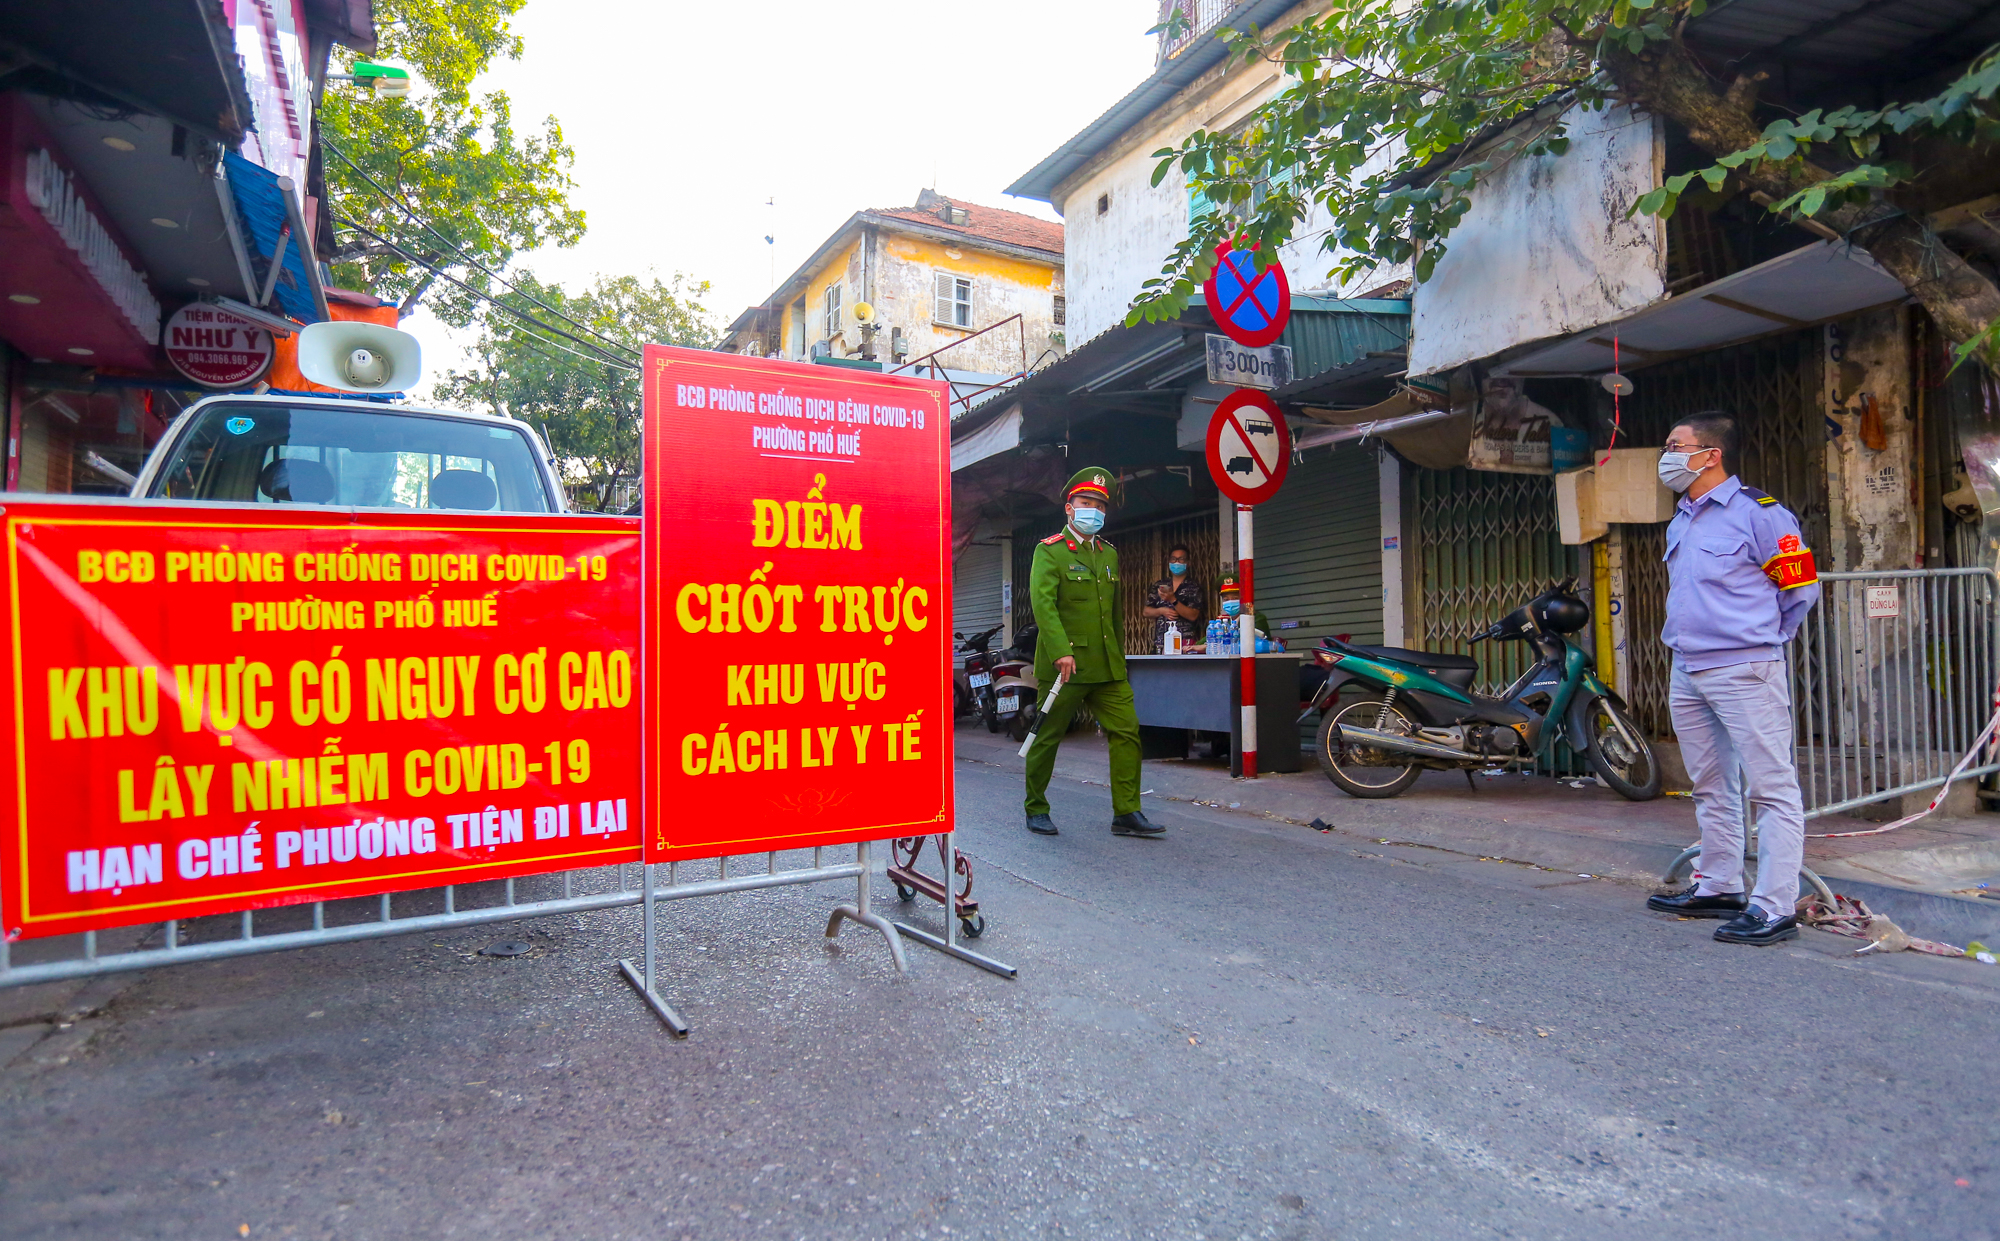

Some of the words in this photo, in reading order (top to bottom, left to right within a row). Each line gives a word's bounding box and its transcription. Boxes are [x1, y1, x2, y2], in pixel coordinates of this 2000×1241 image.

[172, 327, 237, 348] NHƯ
[243, 327, 260, 350] Ý
[184, 309, 213, 324] TIỆM
[188, 352, 248, 366] 094.3066.969
[225, 371, 248, 381] CÔNG
[1225, 350, 1277, 377] 300m
[677, 384, 706, 409] BCĐ
[709, 385, 755, 413] PHÒNG
[758, 388, 802, 418] CHỐNG
[805, 398, 835, 424] DỊCH
[837, 398, 870, 427] BỆNH
[873, 405, 925, 430] COVID-19
[753, 424, 806, 452] PHƯỜNG
[809, 426, 834, 455] PHỐ
[837, 429, 861, 456] HUẾ
[751, 473, 863, 551] ĐIỂM
[78, 549, 155, 583] BCĐ
[166, 544, 285, 582] PHÒNG
[295, 543, 401, 582] CHỐNG
[410, 554, 478, 588] DỊCH
[486, 554, 608, 582] COVID-19
[1785, 560, 1802, 578] TỰ
[232, 594, 365, 632] PHƯỜNG
[374, 590, 434, 629] PHỐ
[443, 590, 499, 627] HUẾ
[675, 561, 803, 634] CHỐT
[814, 577, 928, 646] TRỰC
[48, 666, 159, 741] KHU
[174, 656, 274, 747] VỰC
[290, 645, 351, 728] CÓ
[365, 655, 480, 722] NGUY
[494, 646, 547, 715] CƠ
[558, 650, 632, 711] CAO
[727, 663, 804, 706] KHU
[816, 657, 886, 711] VỰC
[681, 722, 788, 776] CÁCH
[801, 726, 839, 768] LY
[850, 724, 873, 764] Y
[882, 708, 924, 762] TẾ
[118, 755, 215, 823] LÂY
[232, 736, 389, 814] NHIỄM
[404, 738, 591, 798] COVID-19
[66, 843, 163, 896] HẠN
[178, 821, 263, 881] CHẾ
[276, 816, 436, 870] PHƯƠNG
[447, 804, 523, 852] TIỆN
[534, 804, 569, 840] ĐI
[580, 798, 627, 839] LẠI
